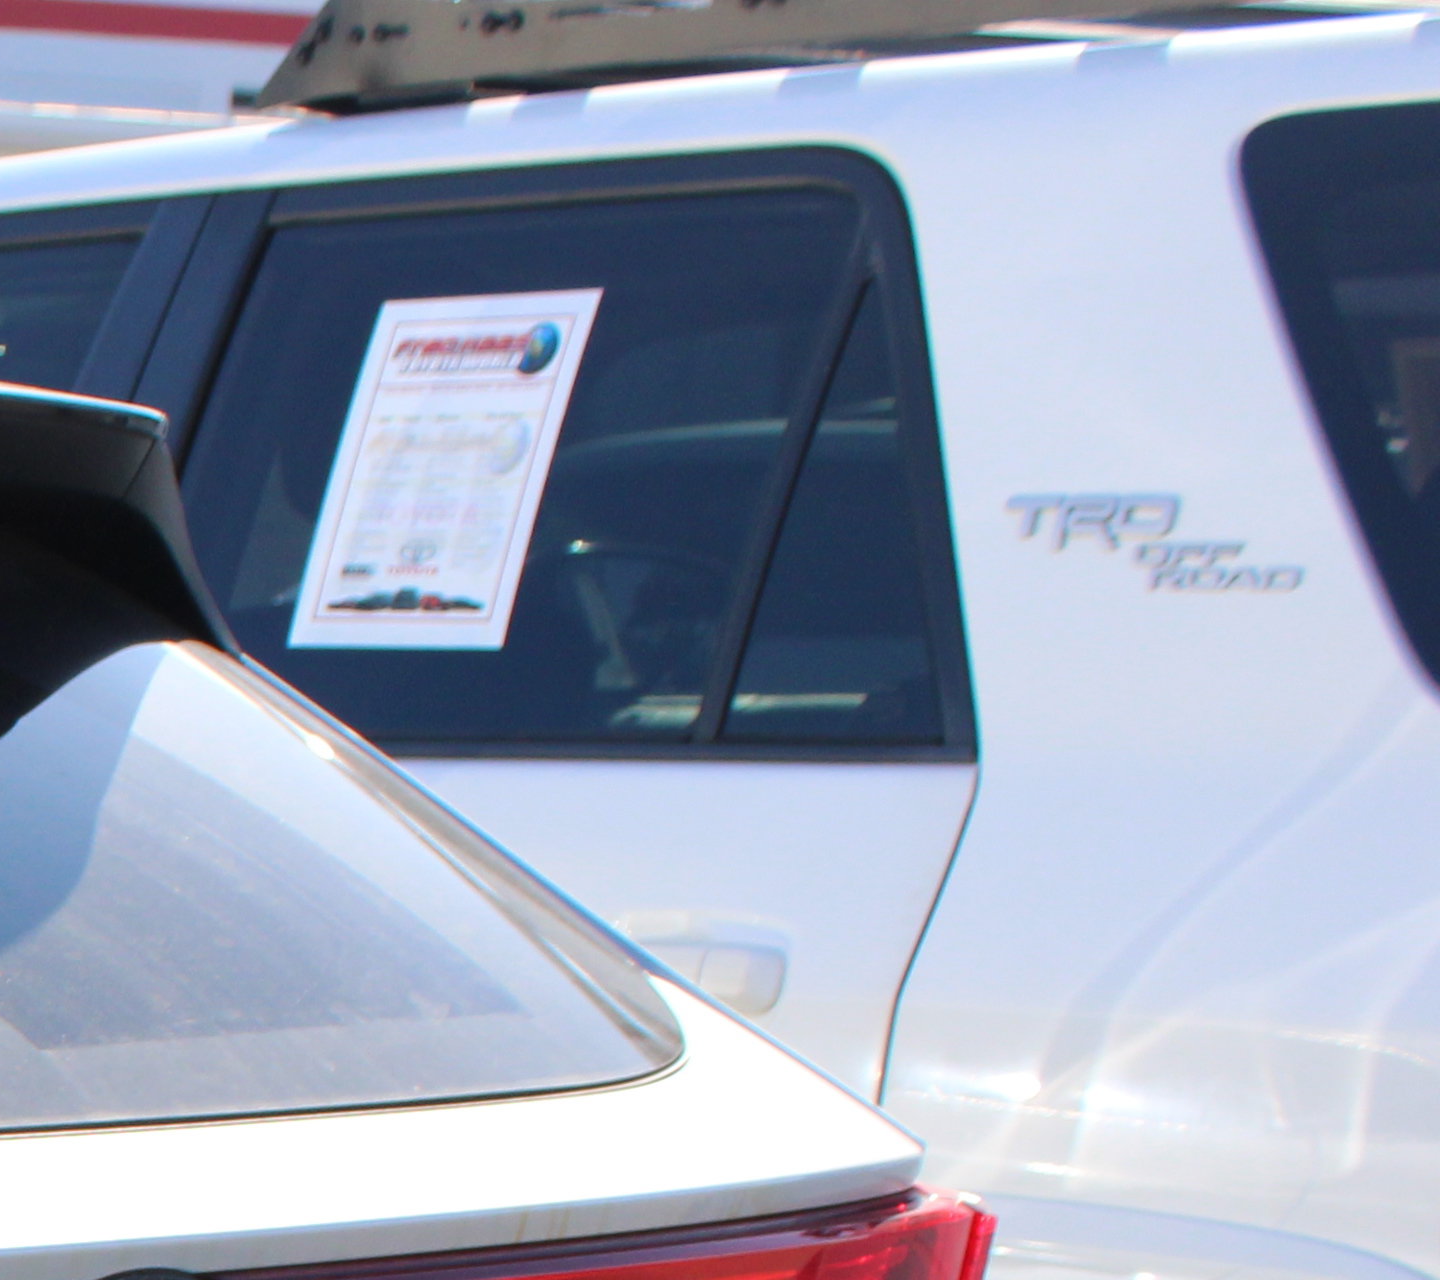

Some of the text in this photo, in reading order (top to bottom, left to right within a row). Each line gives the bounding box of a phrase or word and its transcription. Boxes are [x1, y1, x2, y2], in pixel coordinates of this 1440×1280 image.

[1005, 493, 1182, 552] TRD
[1133, 540, 1247, 568] OFF
[1148, 565, 1306, 593] ROAD
